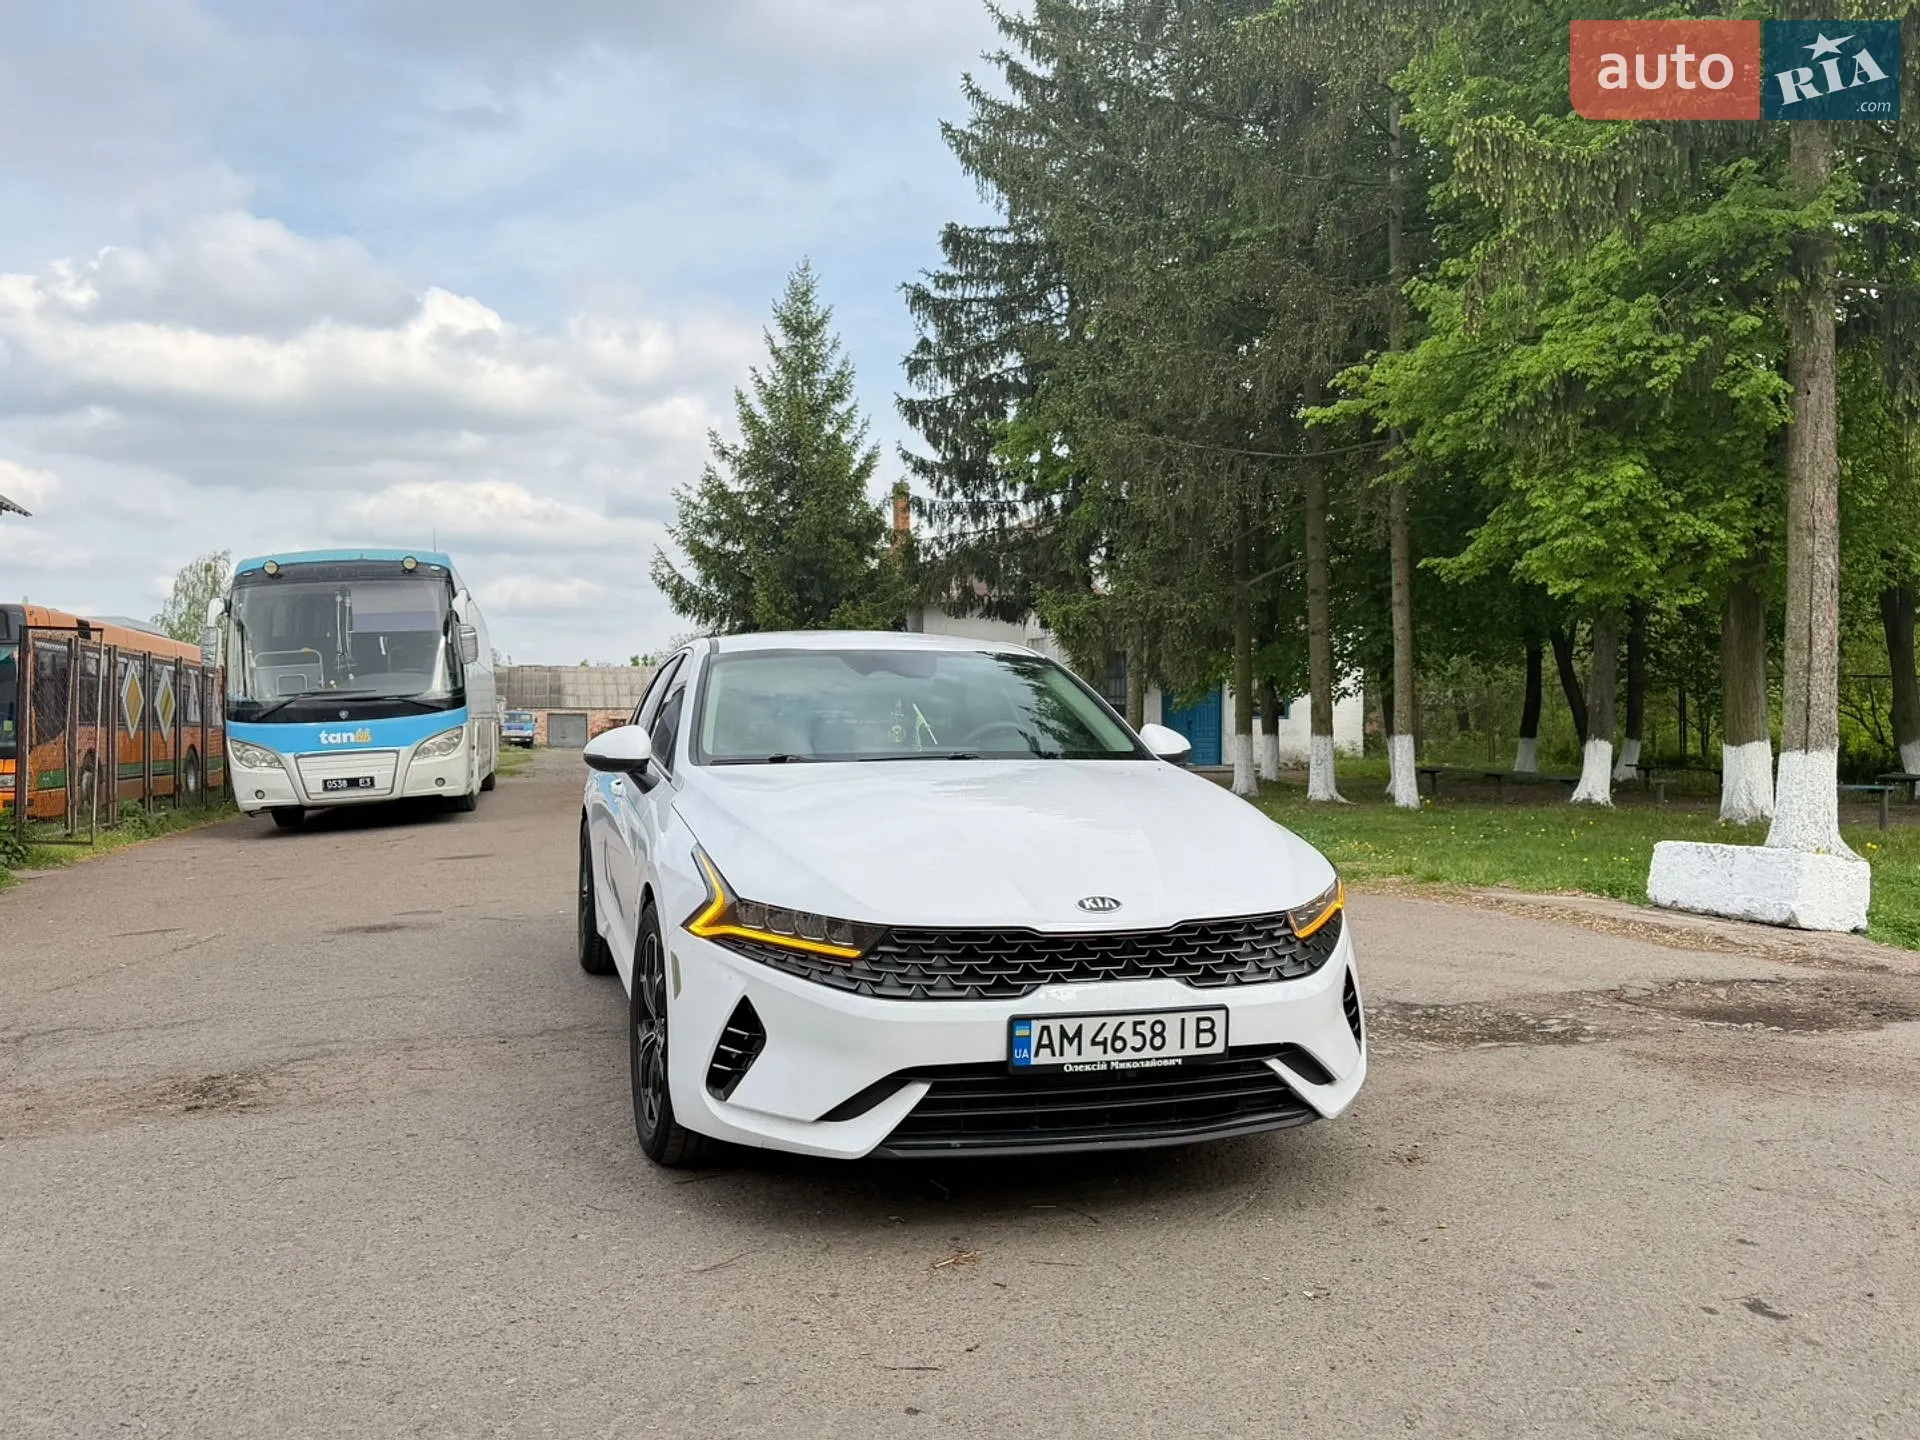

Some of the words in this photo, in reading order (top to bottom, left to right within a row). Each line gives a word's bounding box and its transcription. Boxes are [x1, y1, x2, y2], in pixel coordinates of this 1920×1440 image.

[1082, 898, 1118, 909] KIA
[1033, 1023, 1083, 1058] AM
[1090, 1019, 1167, 1055] 4658
[1014, 1049, 1030, 1060] UA
[1063, 1061, 1108, 1073] Олексій
